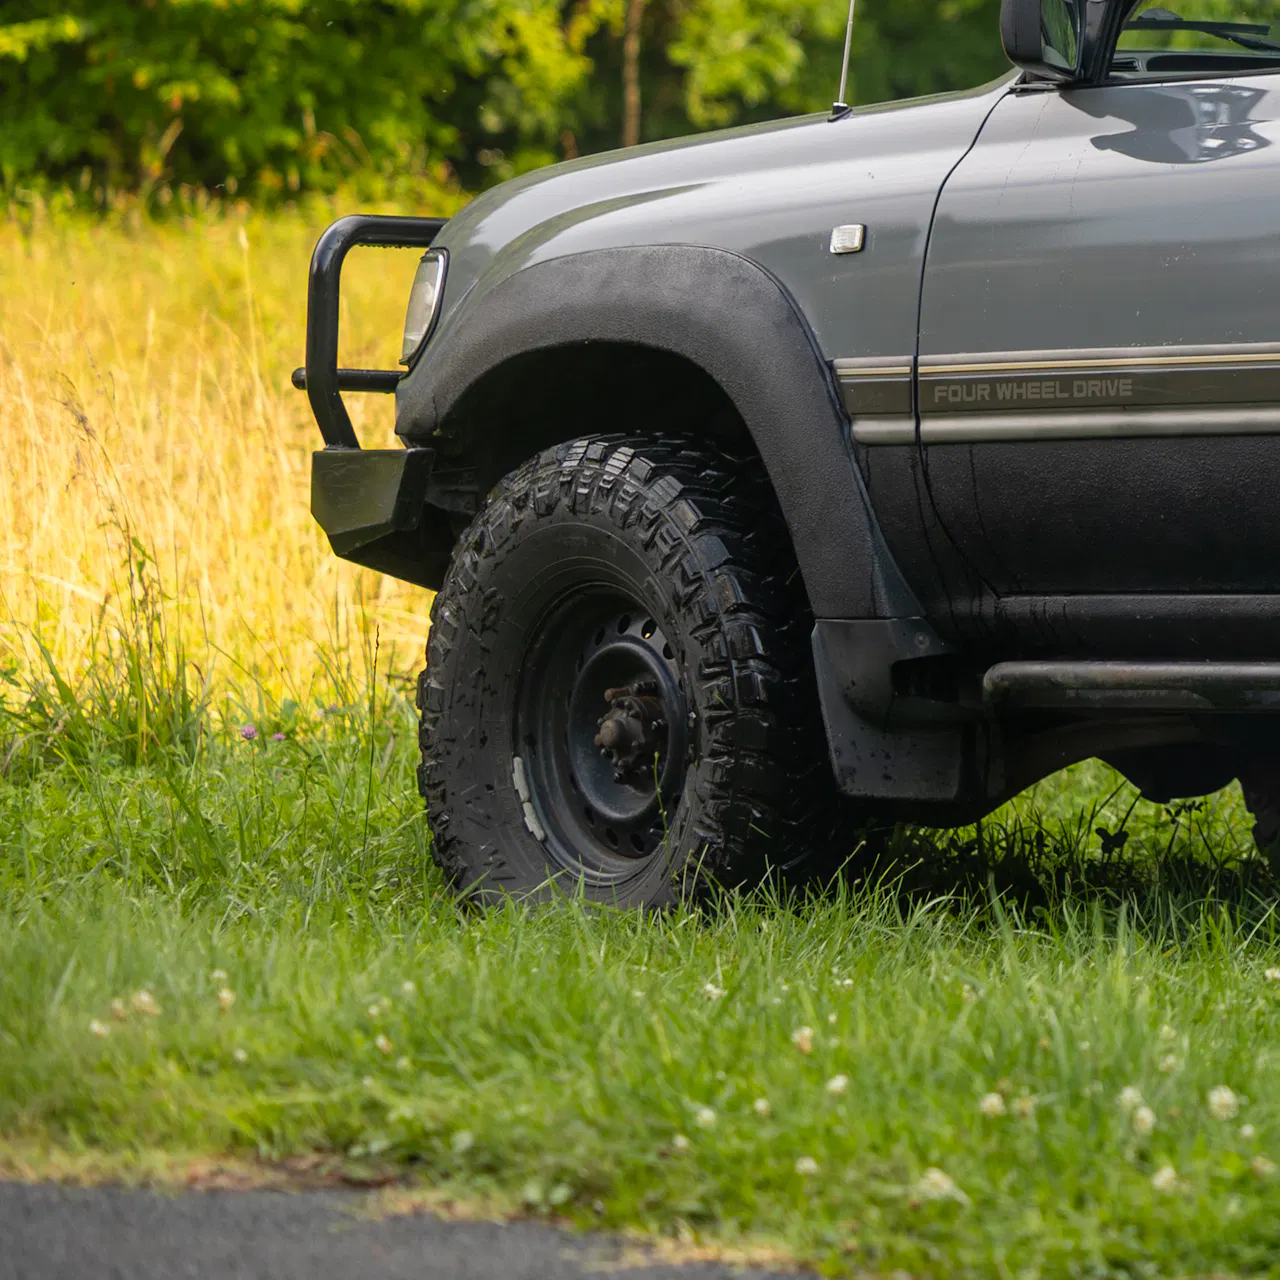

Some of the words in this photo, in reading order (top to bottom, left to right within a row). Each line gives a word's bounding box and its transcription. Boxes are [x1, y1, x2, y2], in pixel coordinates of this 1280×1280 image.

[934, 383, 990, 402] FOUR
[996, 380, 1069, 401] WHEEL
[1073, 378, 1133, 399] DRIVE
